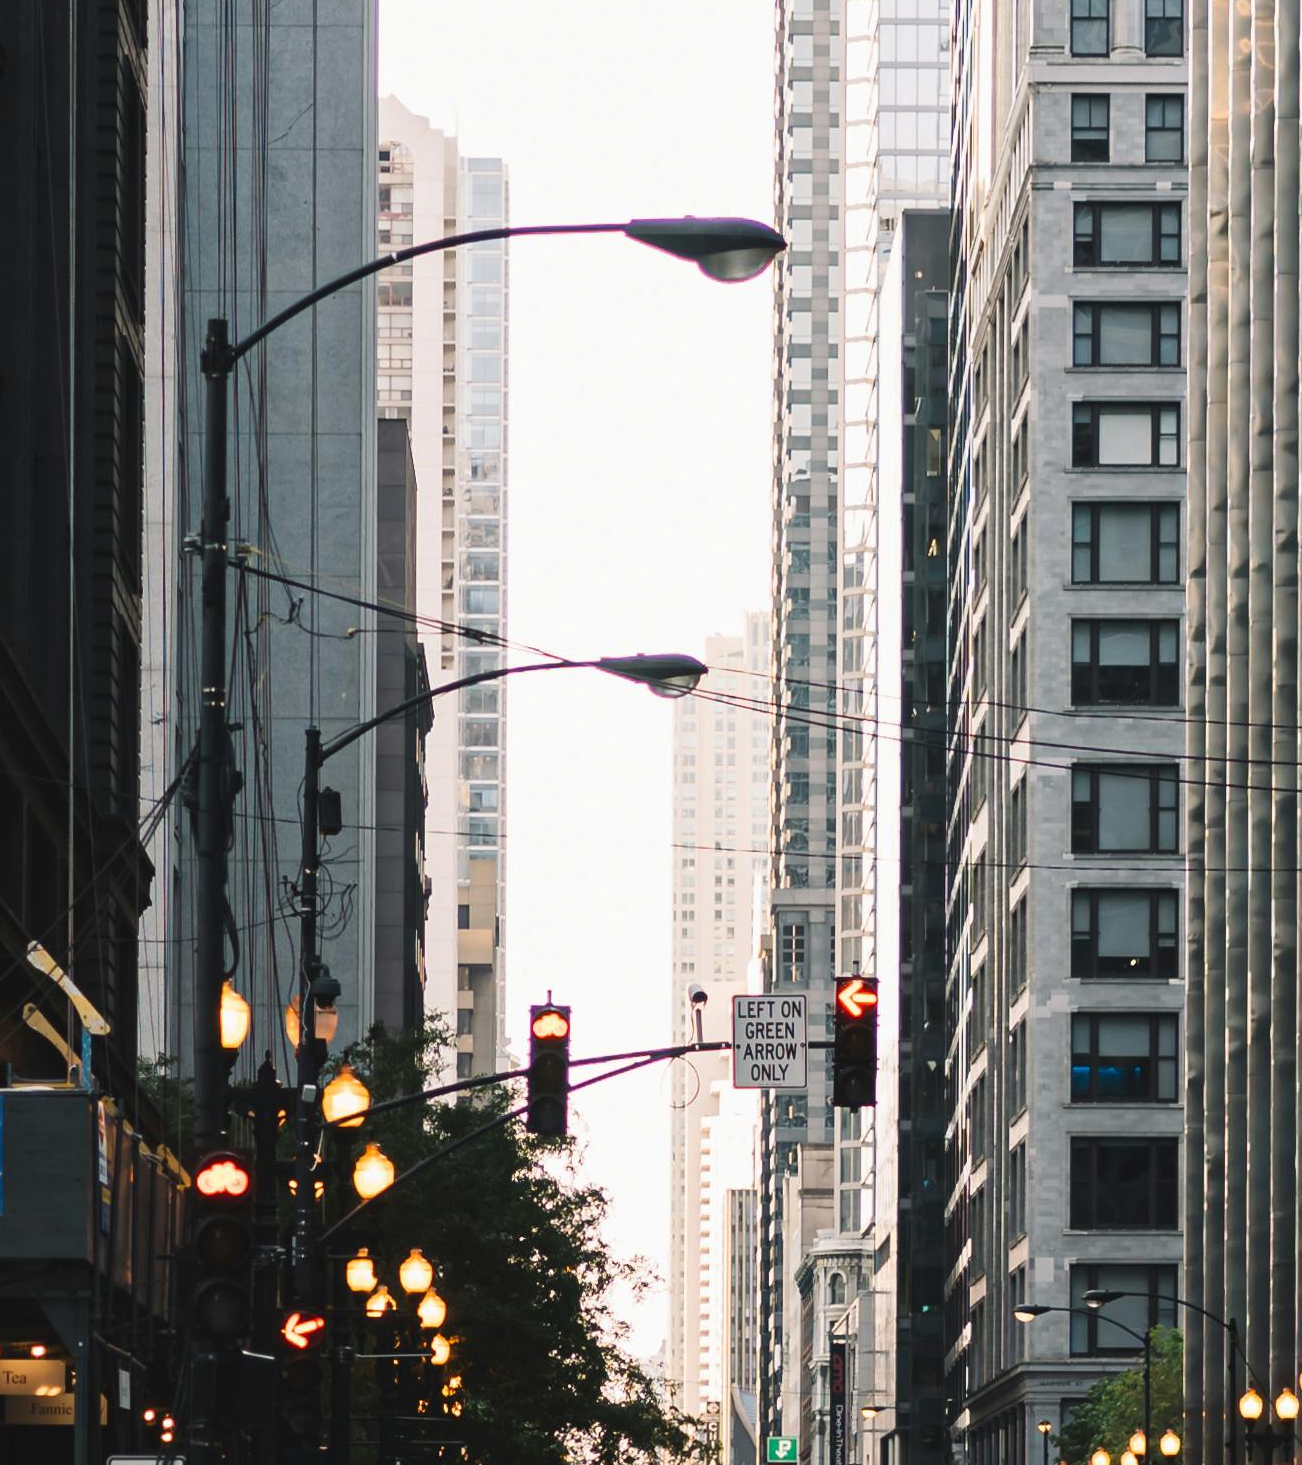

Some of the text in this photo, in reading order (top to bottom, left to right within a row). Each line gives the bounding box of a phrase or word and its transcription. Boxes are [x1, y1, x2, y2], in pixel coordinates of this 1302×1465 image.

[738, 1001, 802, 1018] LEFT ON
[745, 1022, 795, 1039] GREEN
[743, 1043, 797, 1060] ARROW
[751, 1064, 789, 1081] ONLY
[2, 1371, 27, 1385] Tea
[30, 1402, 74, 1416] Fannie
